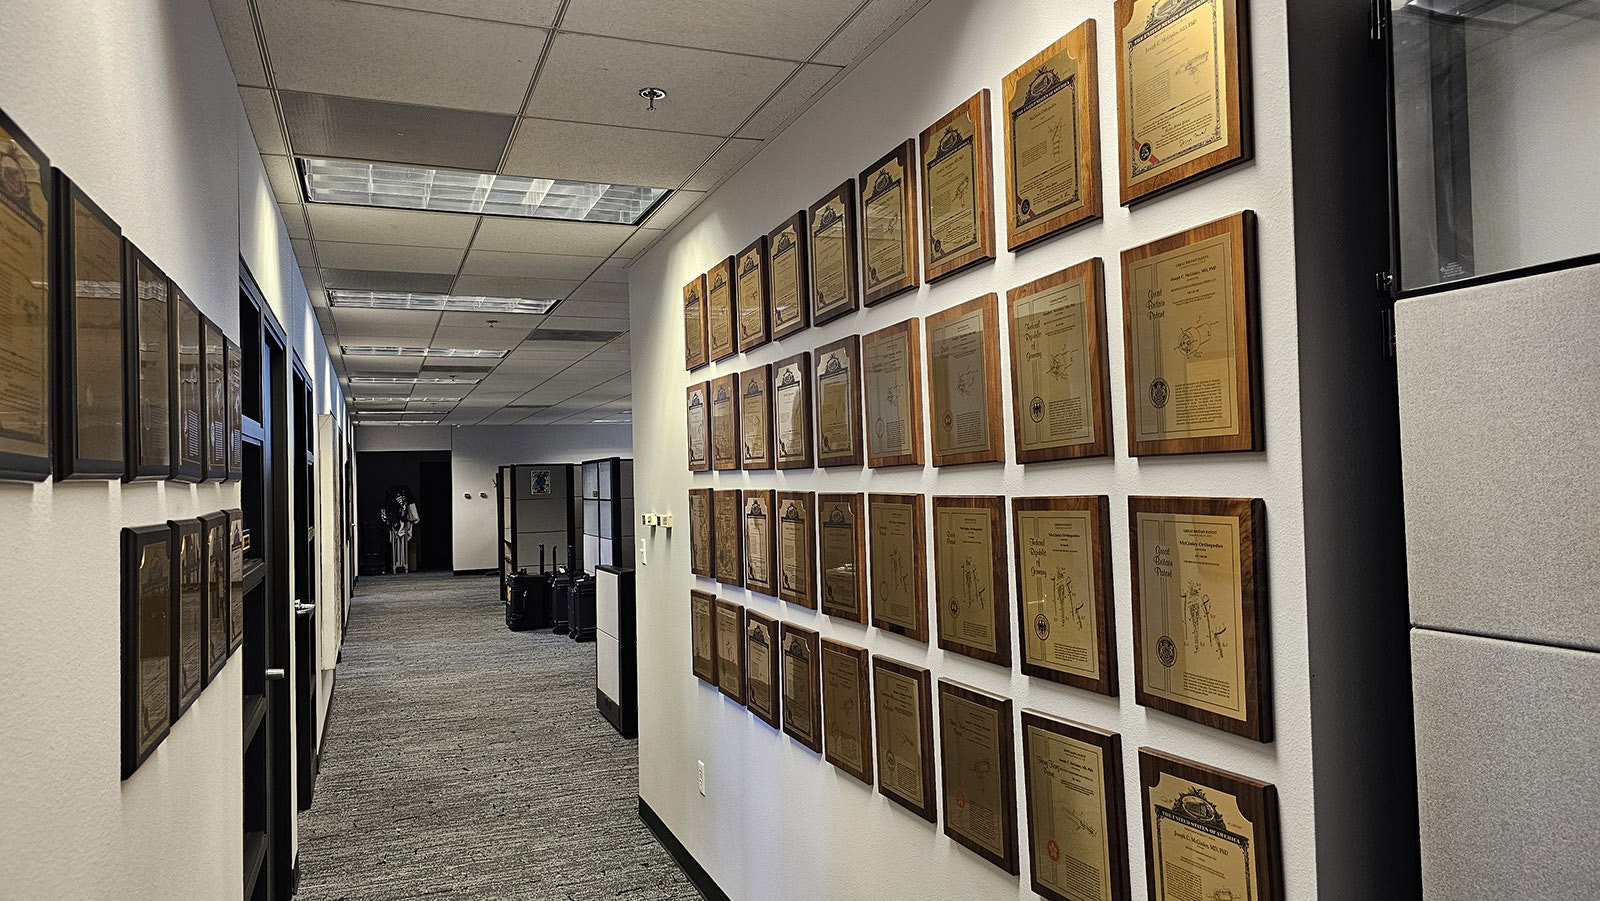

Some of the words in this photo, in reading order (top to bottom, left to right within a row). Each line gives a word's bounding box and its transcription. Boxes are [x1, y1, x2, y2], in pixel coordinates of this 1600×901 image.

[1148, 289, 1162, 301] Great
[1155, 545, 1170, 557] Great
[1172, 813, 1190, 825] UNITED
[1191, 821, 1209, 832] STATES
[1217, 831, 1241, 844] AMERICA
[1174, 830, 1185, 840] Joseph
